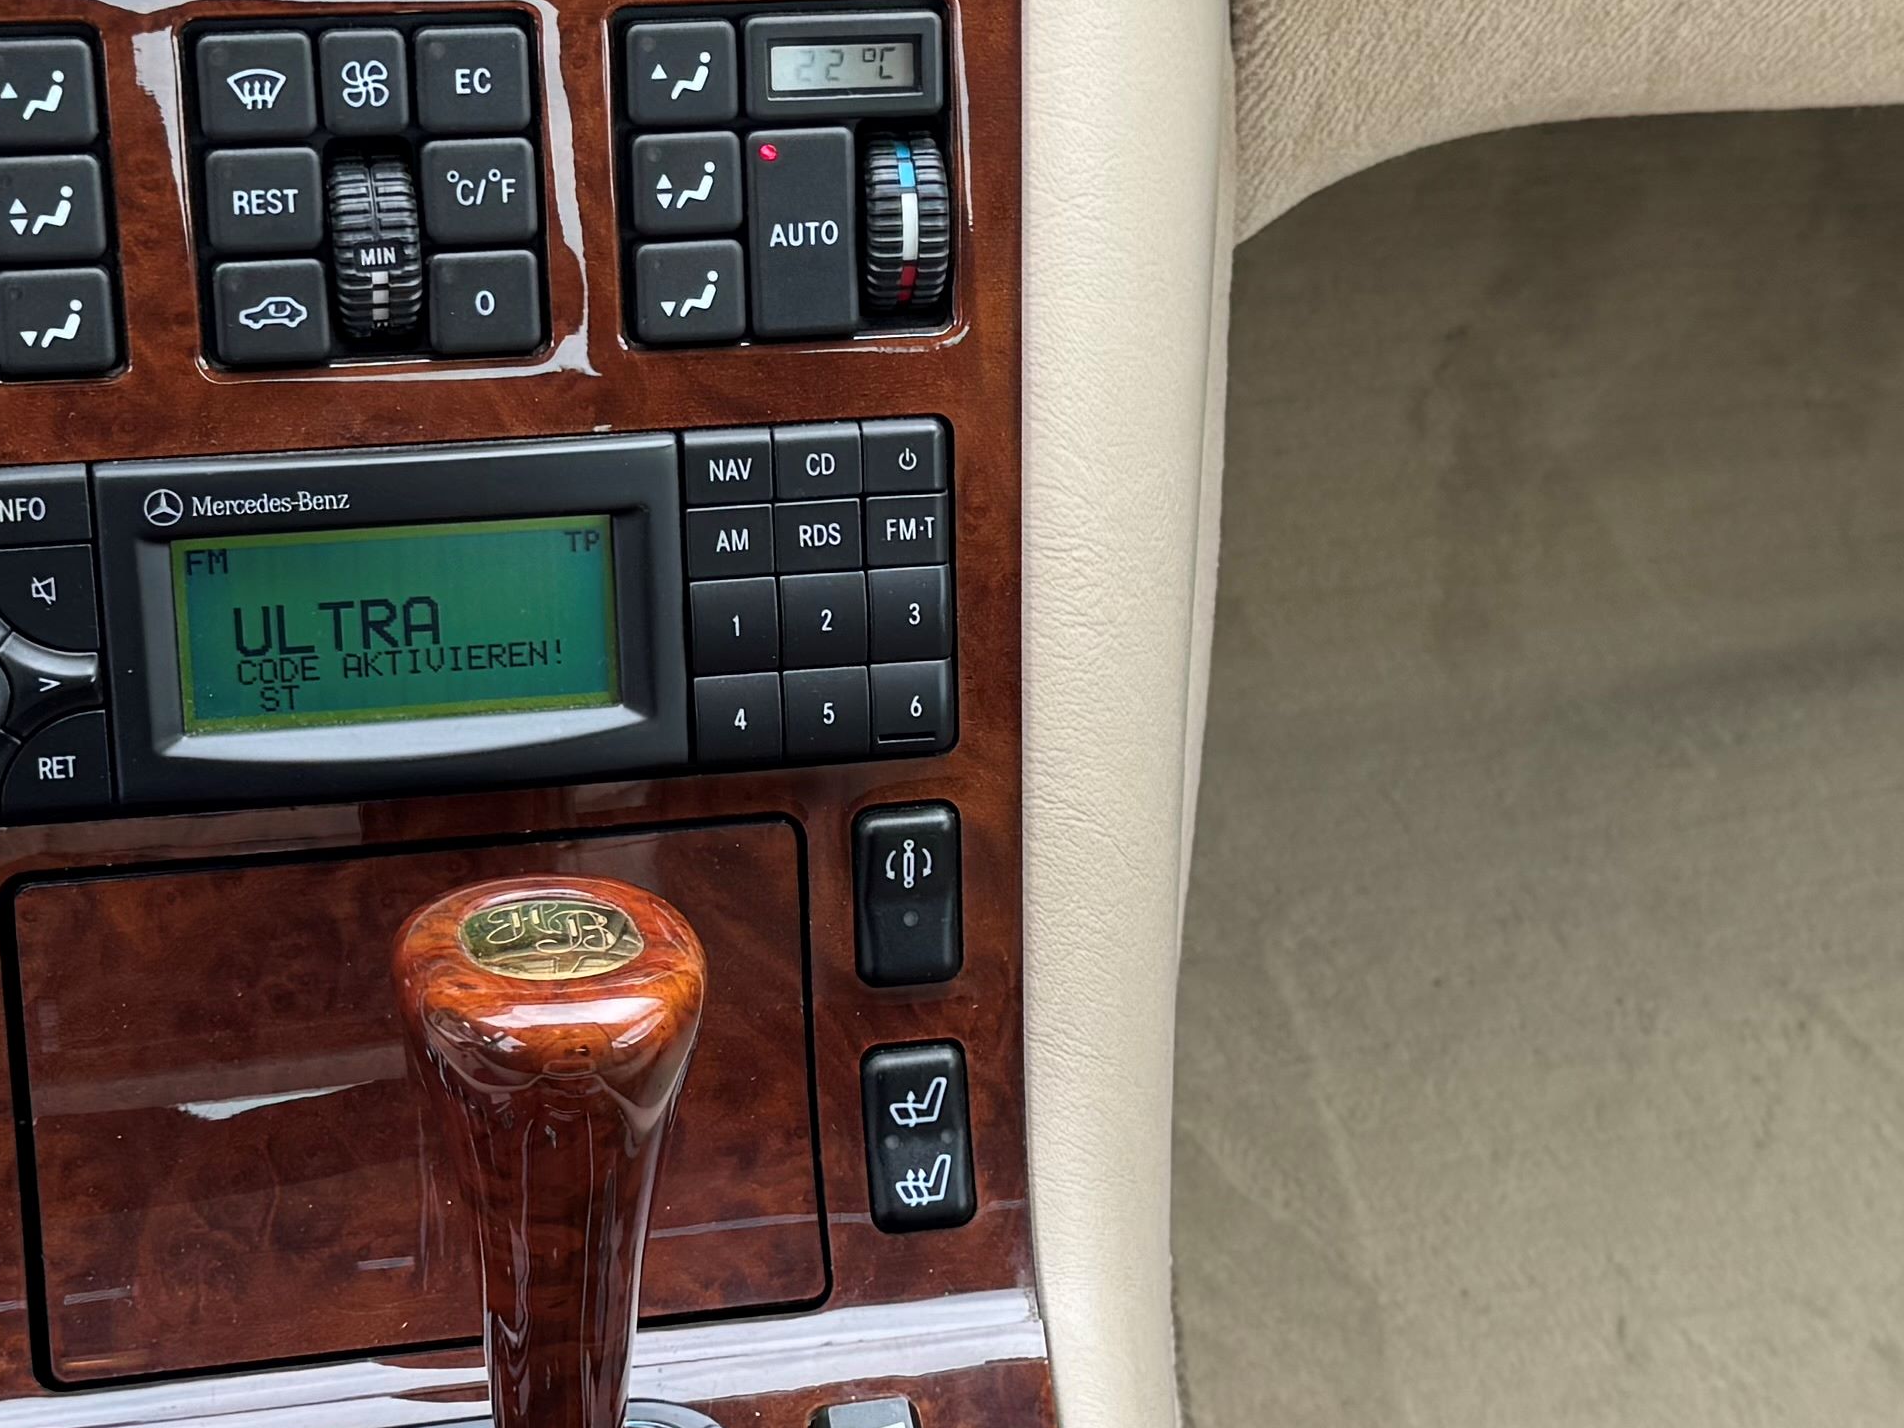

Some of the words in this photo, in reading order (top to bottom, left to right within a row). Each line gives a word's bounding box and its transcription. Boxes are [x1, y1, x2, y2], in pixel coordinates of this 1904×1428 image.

[455, 68, 491, 94] EC
[233, 188, 298, 215] REST
[769, 219, 840, 248] AUTO
[361, 246, 396, 266] MIN
[709, 458, 752, 482] NAV
[806, 453, 835, 476] CD
[192, 490, 350, 518] Mercedes-Benz
[565, 529, 600, 554] TP
[716, 529, 749, 552] AM
[799, 523, 841, 548] RDS
[186, 548, 228, 576] FM
[732, 615, 740, 636] 1
[820, 609, 833, 631] 2
[908, 603, 921, 625] 3
[232, 596, 441, 658] ULTRA
[236, 653, 320, 686] CODE
[343, 638, 563, 679] AKTIVIEREN!
[259, 685, 300, 713] ST
[910, 695, 923, 717] 6
[734, 708, 746, 730] 4
[823, 702, 835, 724] 5
[38, 756, 76, 780] RET
